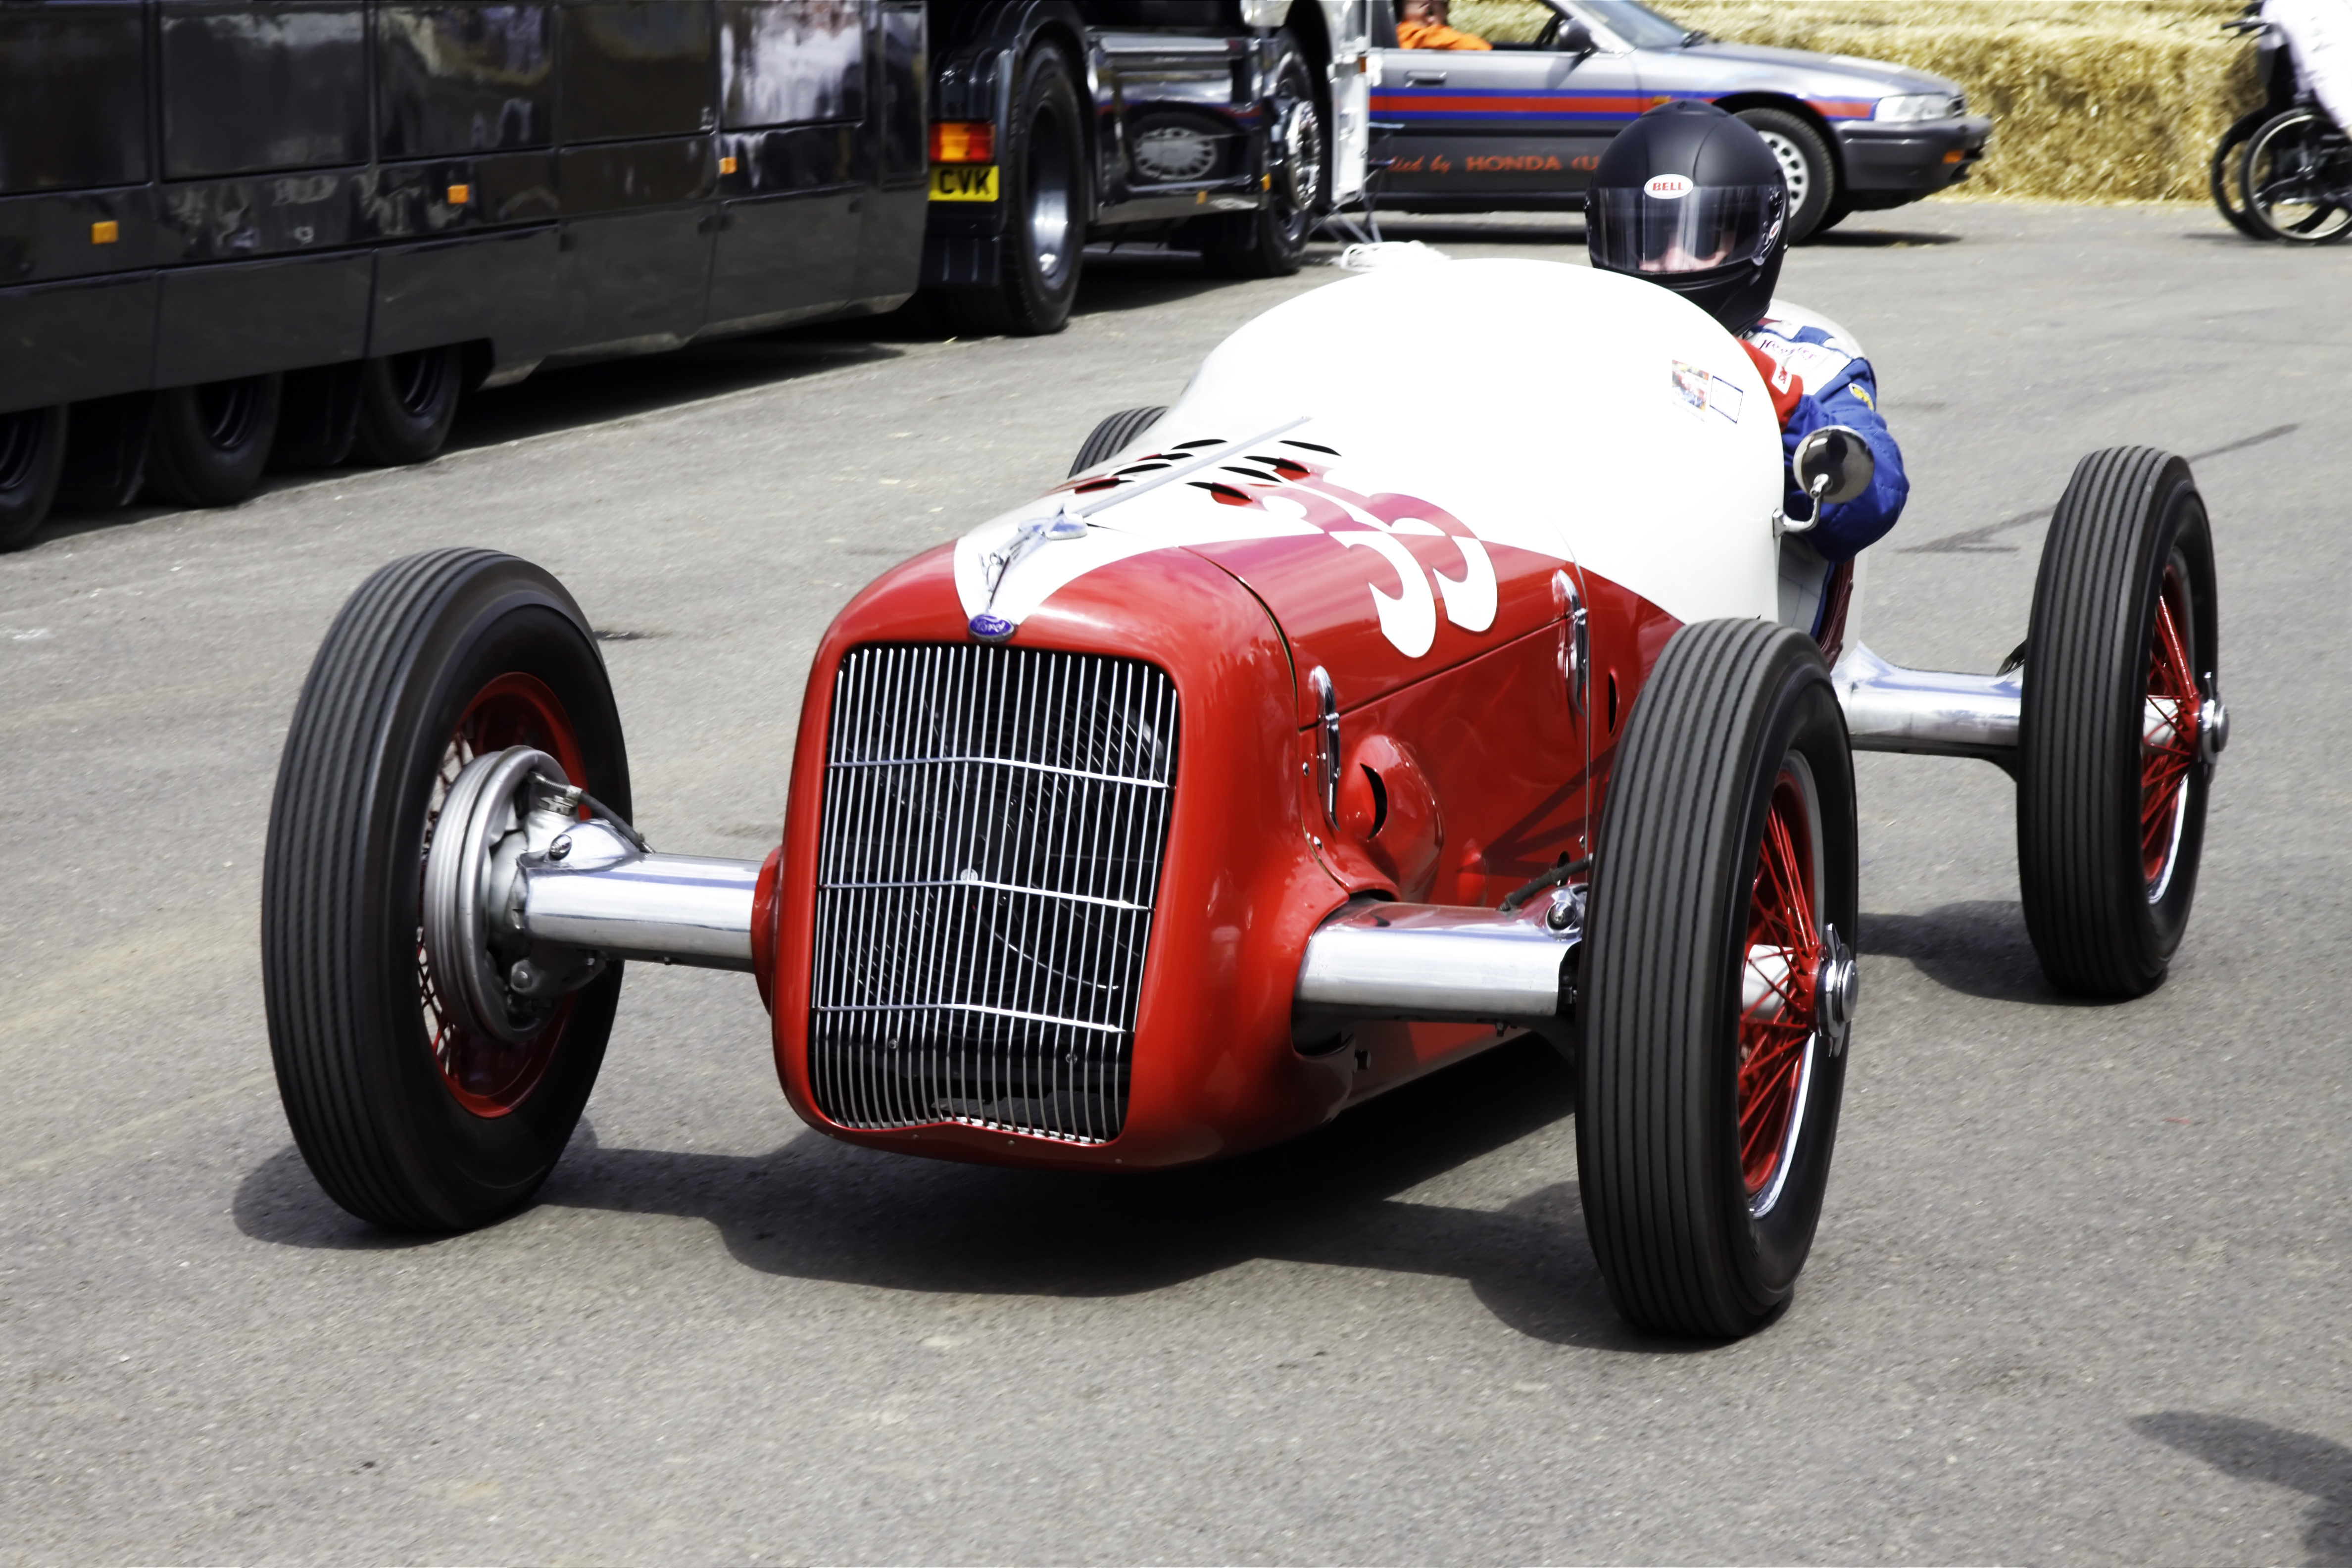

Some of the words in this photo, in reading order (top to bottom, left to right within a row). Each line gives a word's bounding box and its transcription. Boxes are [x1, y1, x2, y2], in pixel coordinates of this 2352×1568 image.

[1430, 154, 1451, 175] by
[1466, 155, 1562, 171] HONDA
[940, 169, 991, 194] CVK
[1653, 182, 1684, 191] BELL
